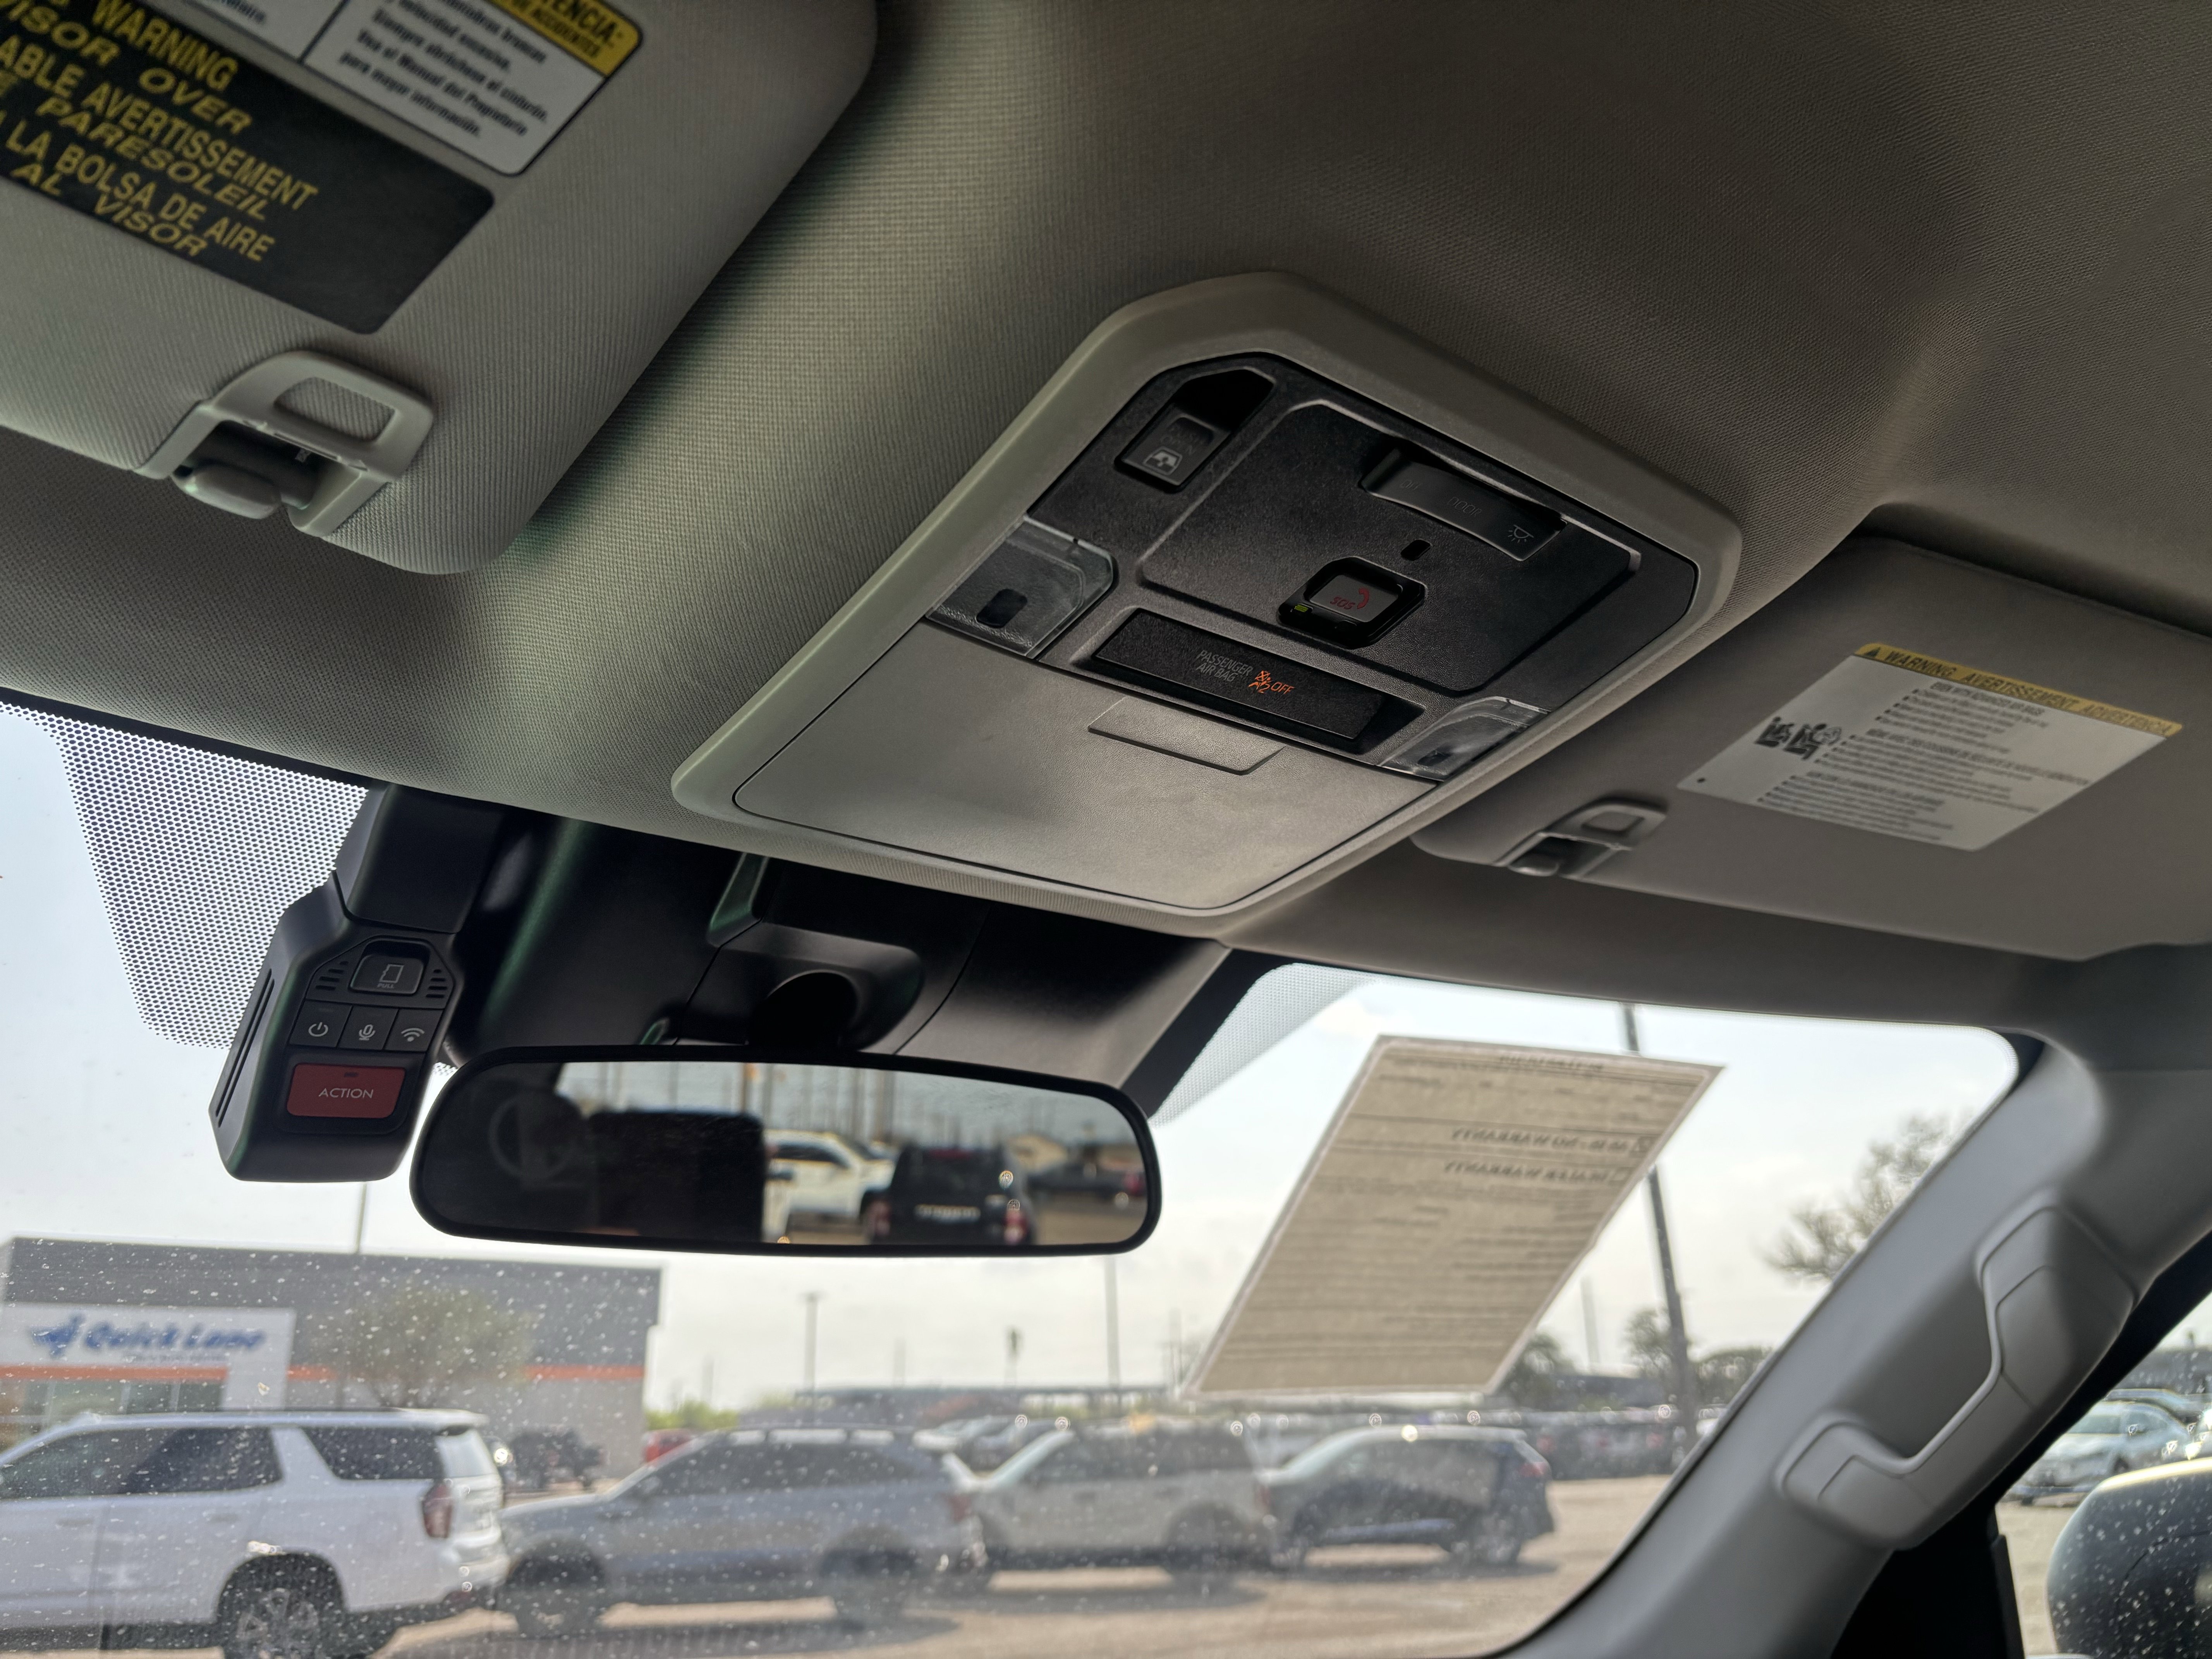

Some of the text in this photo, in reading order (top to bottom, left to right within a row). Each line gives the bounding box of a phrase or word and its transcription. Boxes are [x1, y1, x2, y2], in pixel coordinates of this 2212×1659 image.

[0, 0, 253, 135] ISOR OVER
[91, 0, 239, 91] WARNING
[35, 96, 270, 221] PARESOLEIL
[81, 81, 318, 211] AVERTISSEMENT
[5, 120, 275, 262] LA BOLSA DE AIRE
[10, 162, 209, 258] AL VISOR
[1330, 596, 1356, 610] SOS
[1196, 649, 1254, 676] PASSENGER
[1196, 663, 1238, 682] AIR BAG
[1271, 681, 1295, 695] OFF
[1885, 651, 1957, 677] WARNING
[318, 1088, 374, 1099] ACTION
